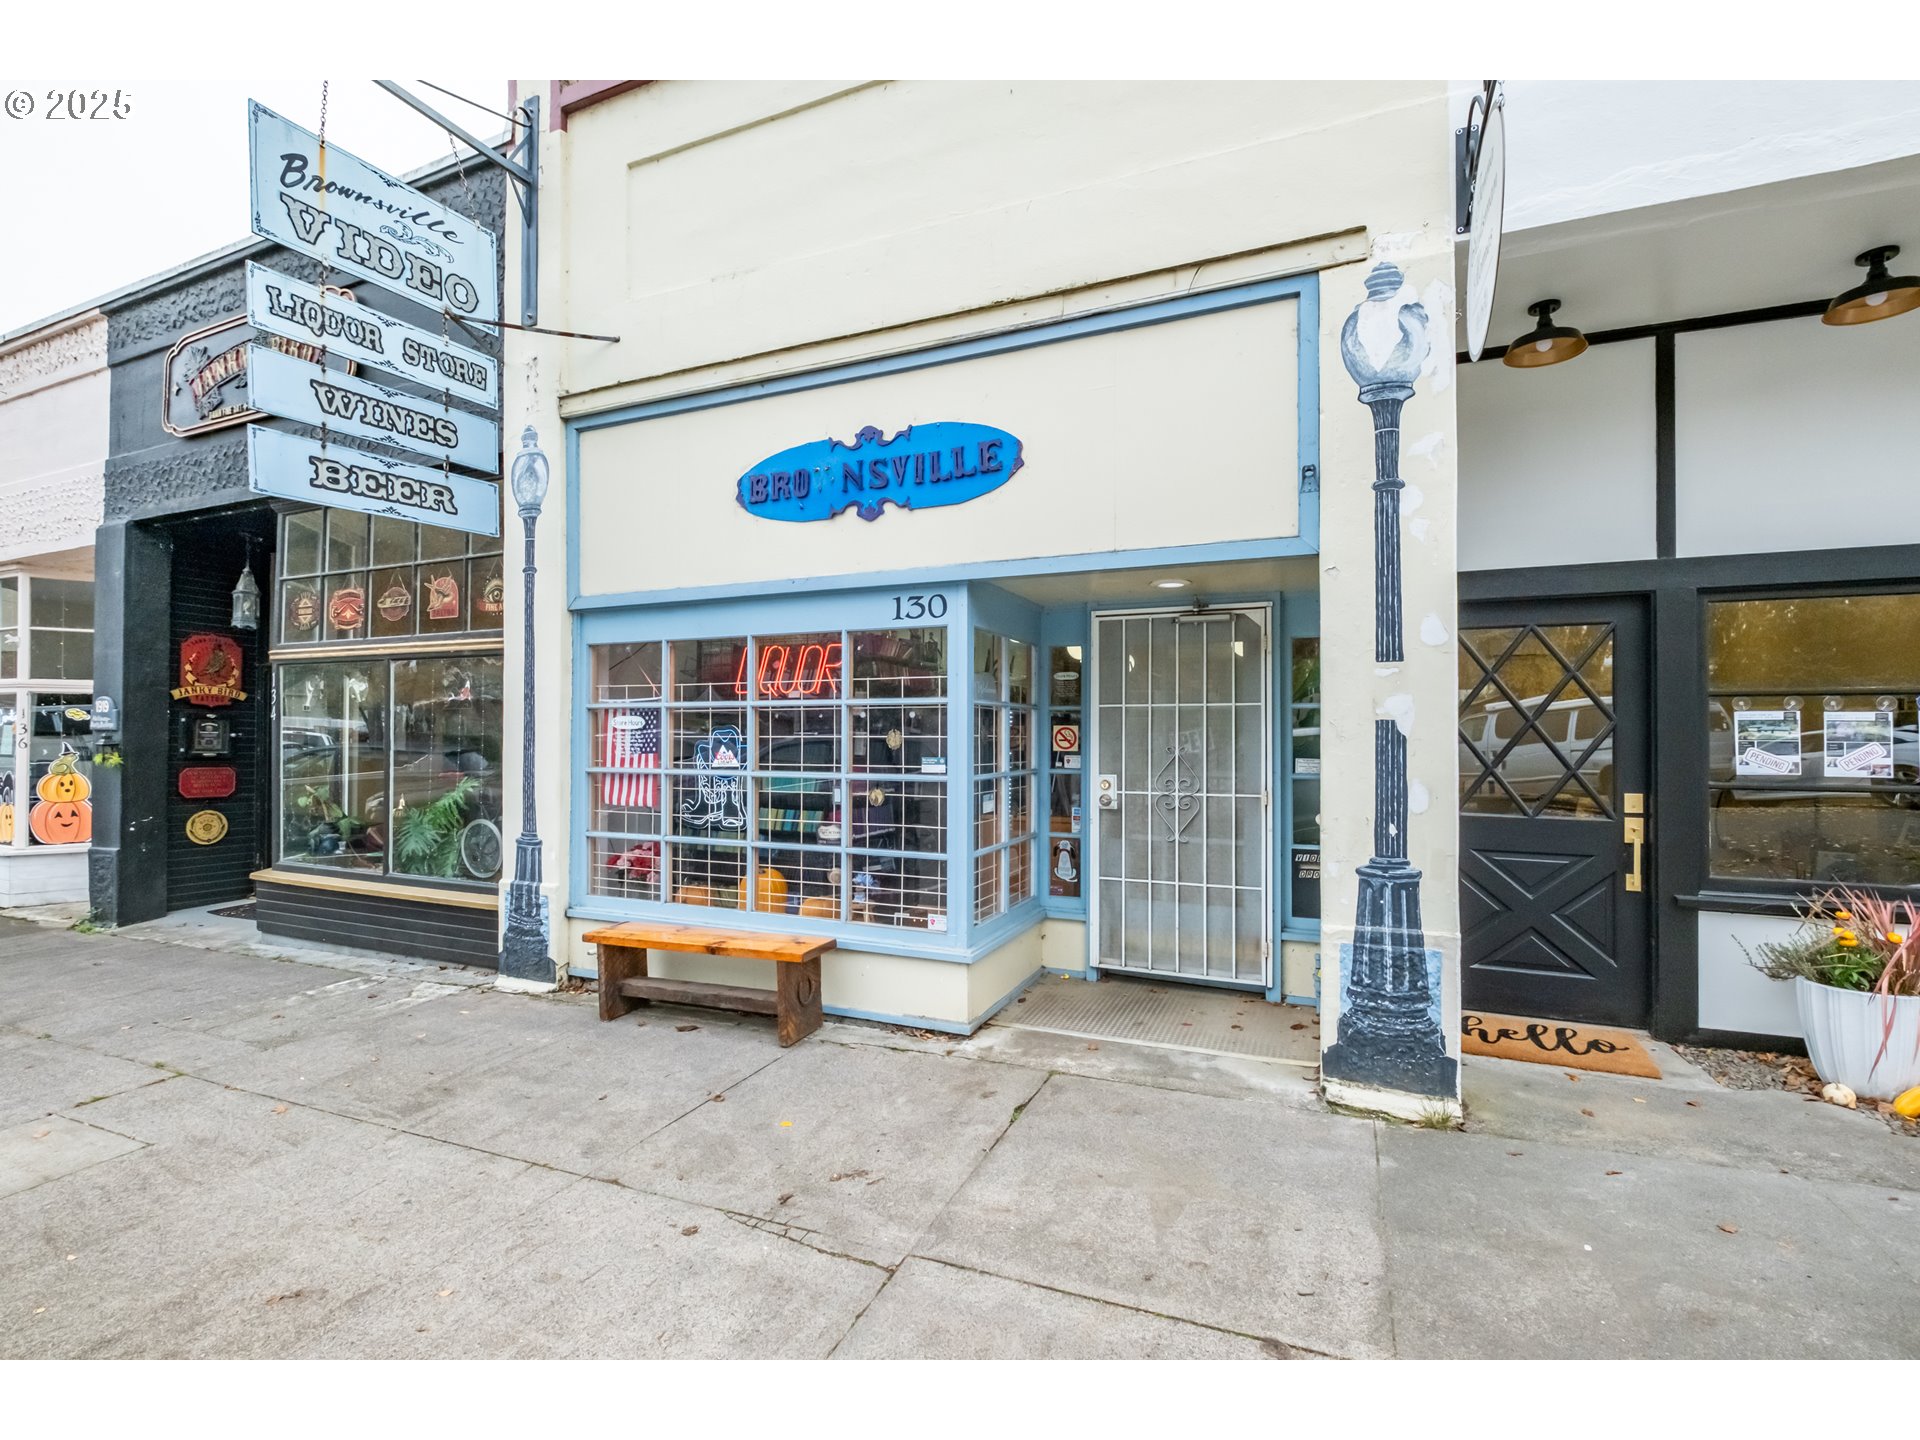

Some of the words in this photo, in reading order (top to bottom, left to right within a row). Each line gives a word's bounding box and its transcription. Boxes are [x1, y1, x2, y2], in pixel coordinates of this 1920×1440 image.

[279, 152, 465, 245] Brownsville
[280, 191, 479, 313] VIDEO
[265, 284, 384, 354] LIQUOR
[402, 336, 488, 391] STORE
[310, 378, 459, 448] WINES
[308, 455, 458, 515] BEER
[748, 438, 1005, 505] BRONSVILLE
[891, 593, 948, 621] 130
[178, 686, 213, 698] JANKY
[217, 687, 241, 699] BIRD
[17, 708, 28, 750] 136
[1749, 752, 1785, 770] PENDING
[1843, 746, 1880, 769] PENDING
[1461, 1015, 1630, 1056] hello
